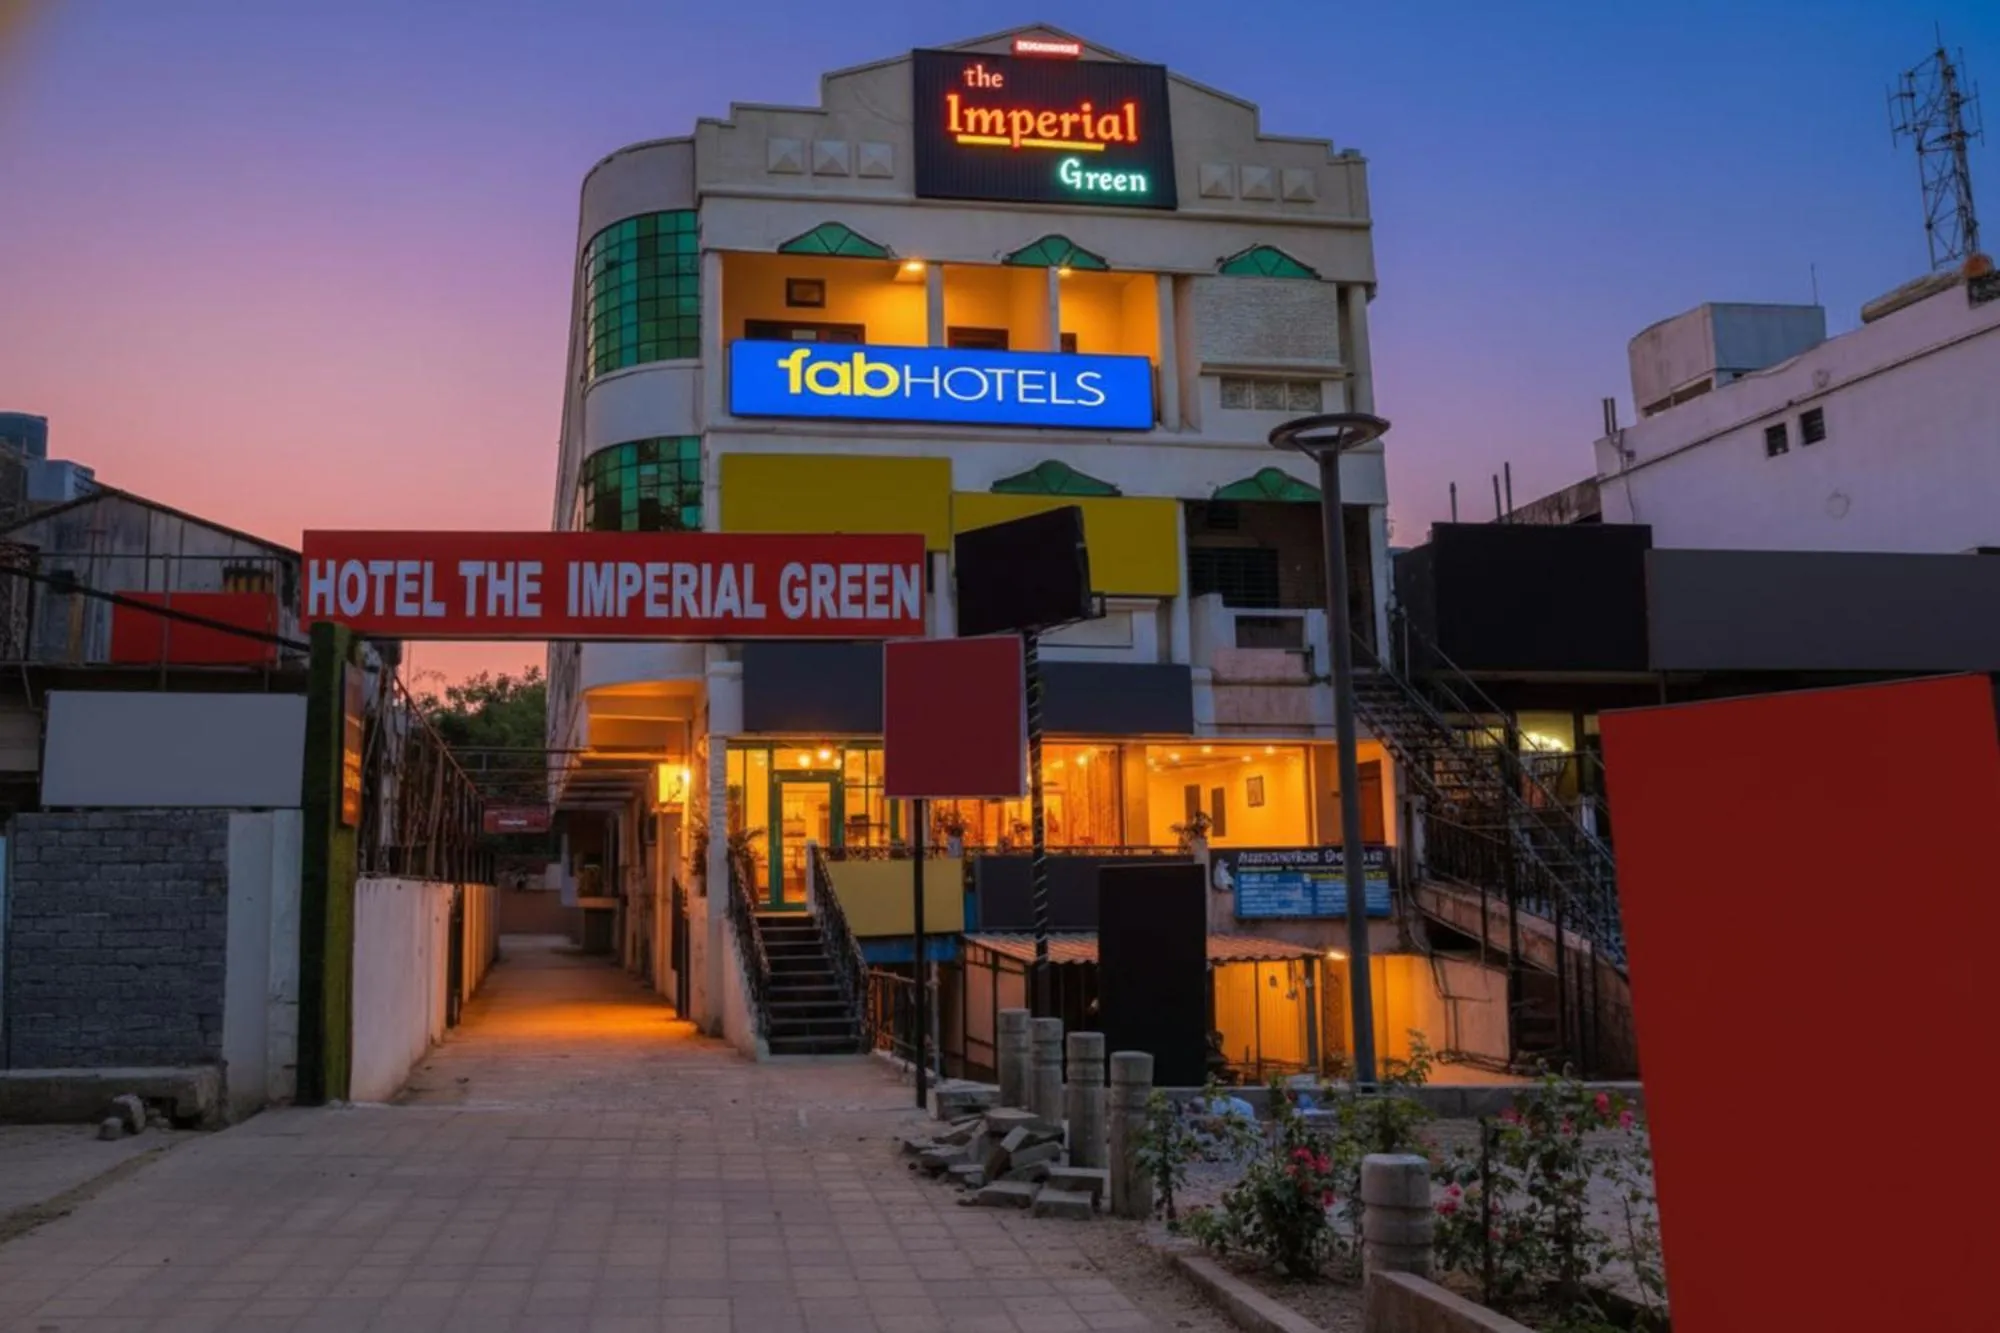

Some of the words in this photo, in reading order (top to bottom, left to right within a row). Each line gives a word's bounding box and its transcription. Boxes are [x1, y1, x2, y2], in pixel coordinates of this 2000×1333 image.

[964, 64, 1004, 88] the
[946, 94, 1139, 148] Imperial
[1060, 157, 1148, 192] Green
[777, 348, 1106, 407] fabHOTELS
[307, 559, 446, 618] HOTEL
[458, 561, 543, 618] THE
[567, 561, 767, 619] IMPERIAL
[779, 562, 920, 620] GREEN
